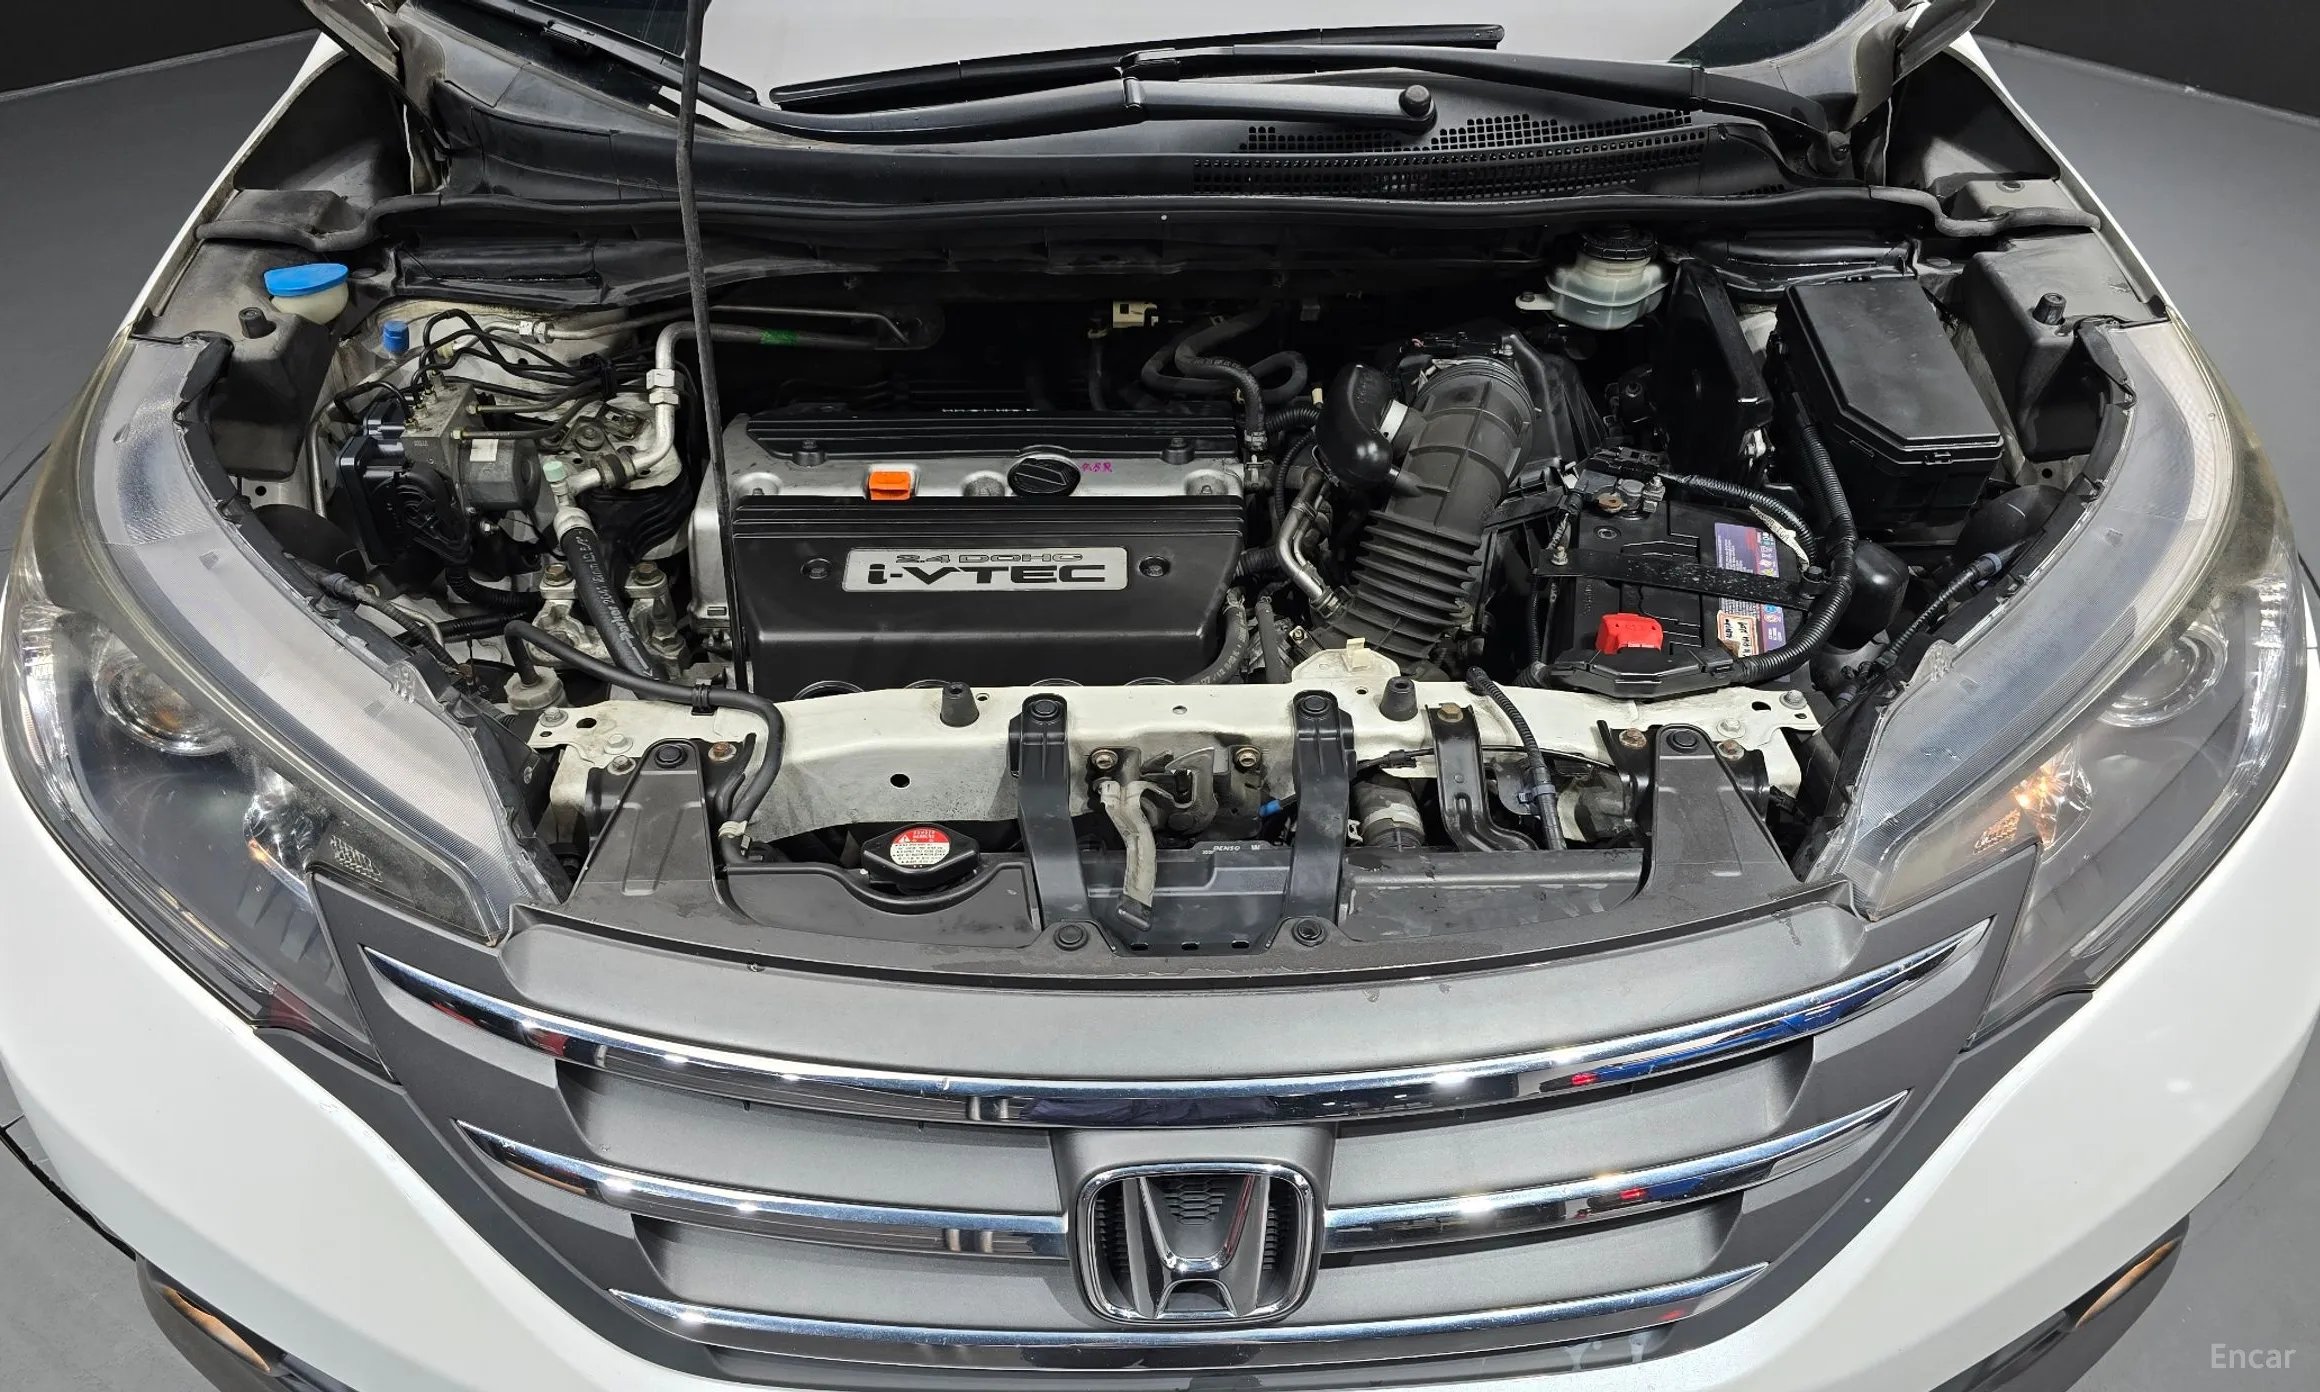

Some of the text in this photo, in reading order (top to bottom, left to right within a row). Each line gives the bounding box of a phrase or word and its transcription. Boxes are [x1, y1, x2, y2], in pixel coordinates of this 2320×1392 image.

[895, 553, 1083, 564] 2.4 DOHC
[868, 563, 1106, 585] i-VTEC
